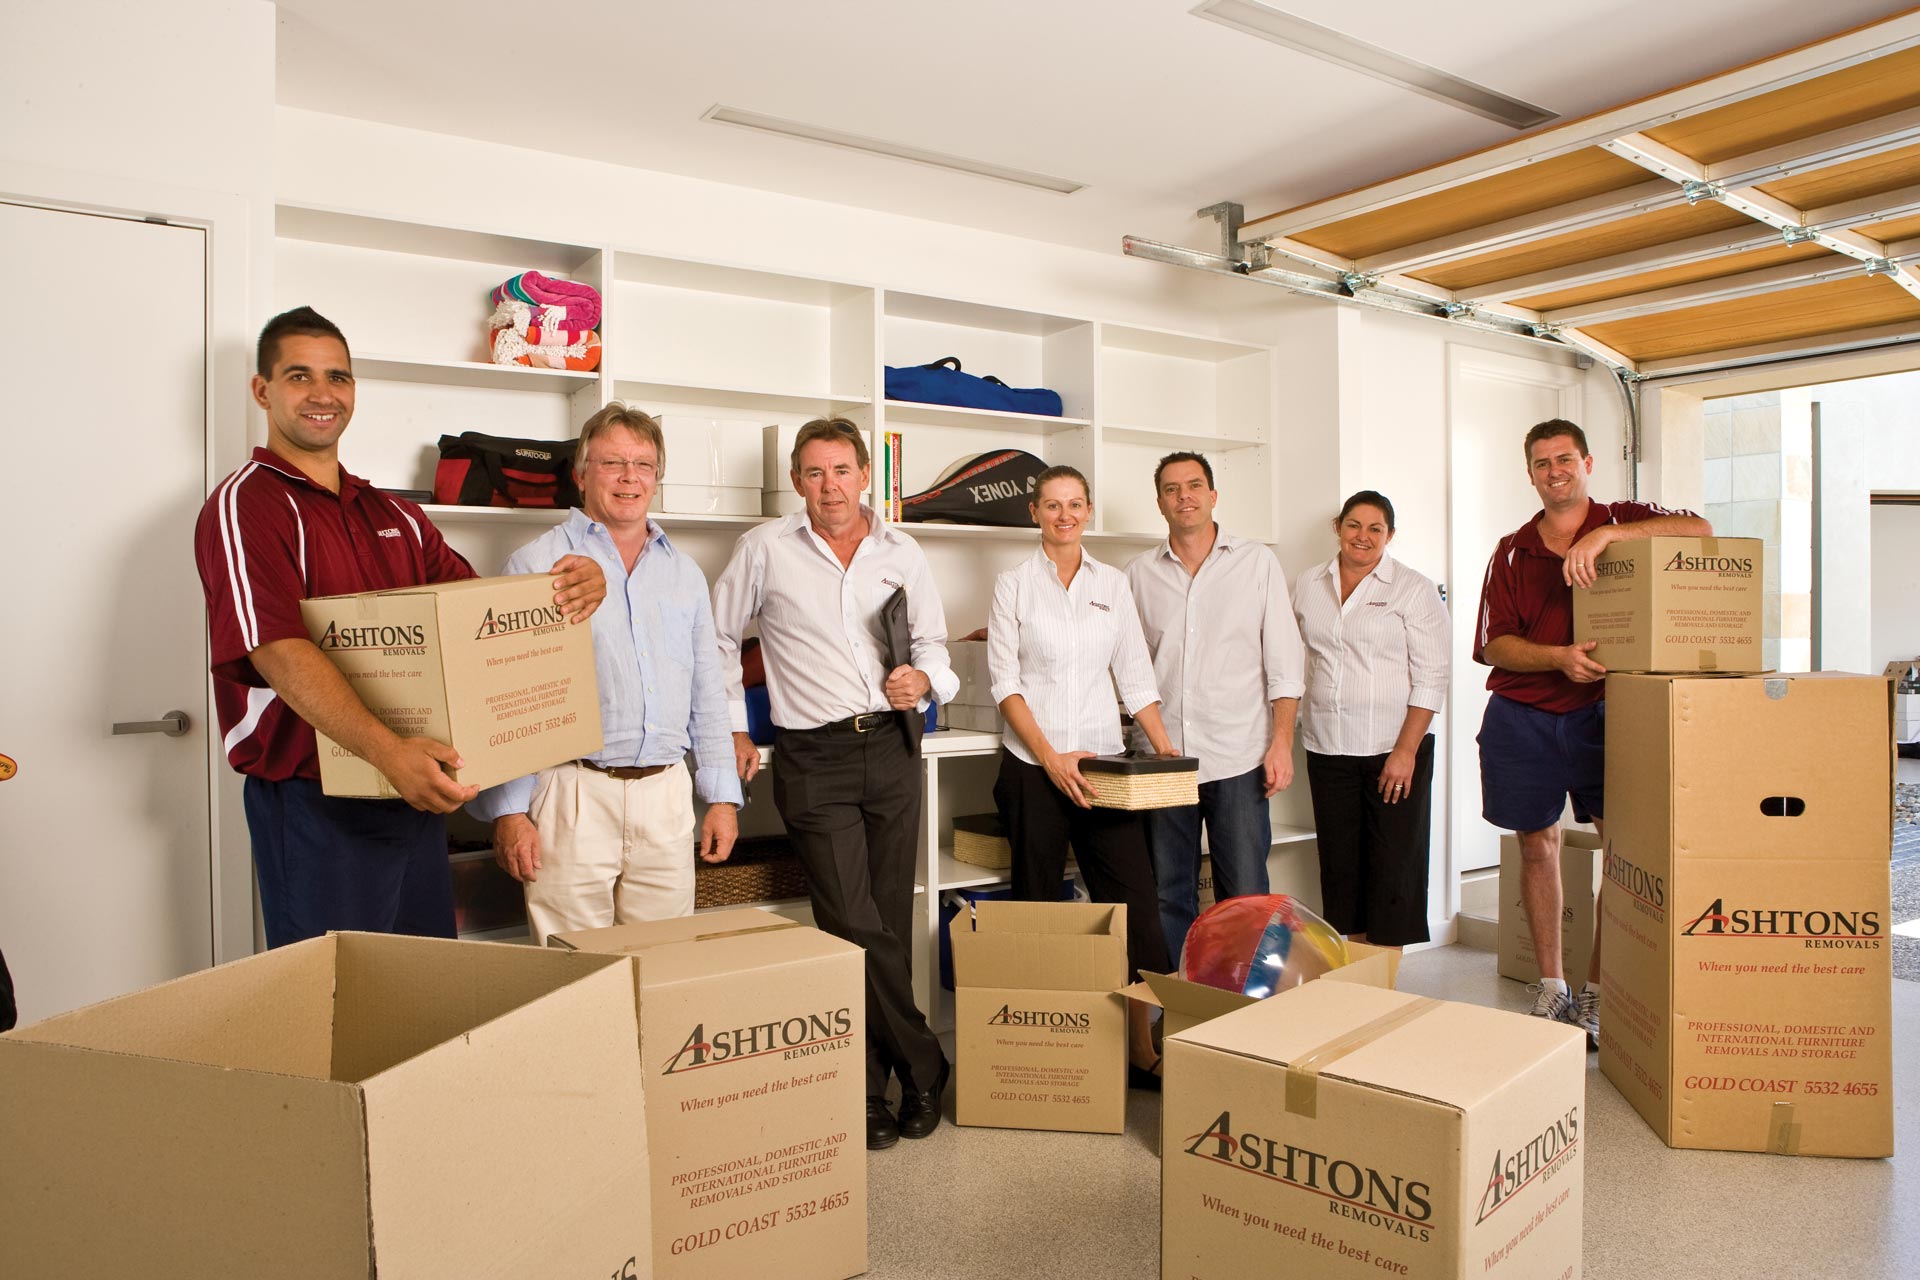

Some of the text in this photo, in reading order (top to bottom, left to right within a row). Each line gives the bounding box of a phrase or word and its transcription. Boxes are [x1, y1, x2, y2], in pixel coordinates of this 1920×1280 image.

[968, 479, 1024, 504] YONEX
[1597, 559, 1634, 576] SHTONS
[1663, 551, 1752, 572] ASHTONS
[320, 620, 425, 649] ASHTONS
[475, 604, 564, 640] ASHTONS
[533, 624, 565, 636] REMOVALS
[383, 648, 425, 656] REMOVALS
[1665, 635, 1752, 645] GOLD COAST 5532 4655
[486, 658, 503, 667] When
[505, 655, 515, 665] you
[517, 650, 530, 661] need
[530, 649, 539, 658] the
[540, 647, 551, 656] best
[362, 670, 377, 678] need
[380, 670, 390, 678] the
[391, 669, 405, 678] best
[486, 678, 571, 705] PROFESSIONAL, DOMESTIC AND
[491, 687, 568, 713] INTERNATIONAL FURNITURE
[380, 707, 416, 715] DOMESTIC
[496, 697, 566, 720] REMOVALS AND STORAGE
[489, 712, 577, 747] GOLD COAST 5532 4655
[1602, 838, 1664, 907] ASHTONS
[1633, 898, 1664, 924] REMOVALS
[1680, 898, 1879, 936] ASHTONS
[1804, 940, 1879, 949] REMOVALS
[1699, 961, 1865, 975] When you need the best care
[987, 1004, 1089, 1027] ASHTONS
[661, 1007, 852, 1075] ASHTONS
[1050, 1027, 1089, 1035] REMOVALS
[1687, 1021, 1875, 1036] PROFESSIONAL, DOMESTIC AND
[1696, 1033, 1865, 1048] INTERNATIONAL FURNITURE
[783, 1038, 850, 1060] REMOVALS
[1705, 1045, 1857, 1059] REMOVALS AND STORAGE
[995, 1071, 1047, 1079] INTERNATIONAL
[1684, 1076, 1878, 1096] GOLD COAST 5532 4655
[680, 1068, 838, 1113] When you need the best care
[990, 1091, 1090, 1104] GOLD COAST 5532 4655
[671, 1132, 847, 1186] PROFESSIONAL, DOMESTIC AND
[1184, 1111, 1432, 1221] ASHTONS
[1475, 1106, 1578, 1226] ASHTONS
[1542, 1146, 1577, 1184] REMOVALS
[680, 1147, 839, 1198] INTERNATIONAL FURNITURE
[690, 1162, 833, 1209] REMOVALS AND STORAGE
[671, 1191, 850, 1255] GOLD COAST 5532 4655
[1329, 1200, 1430, 1243] REMOVALS
[1484, 1187, 1571, 1272] When you need the best care
[1202, 1194, 1409, 1276] When you need the best care
